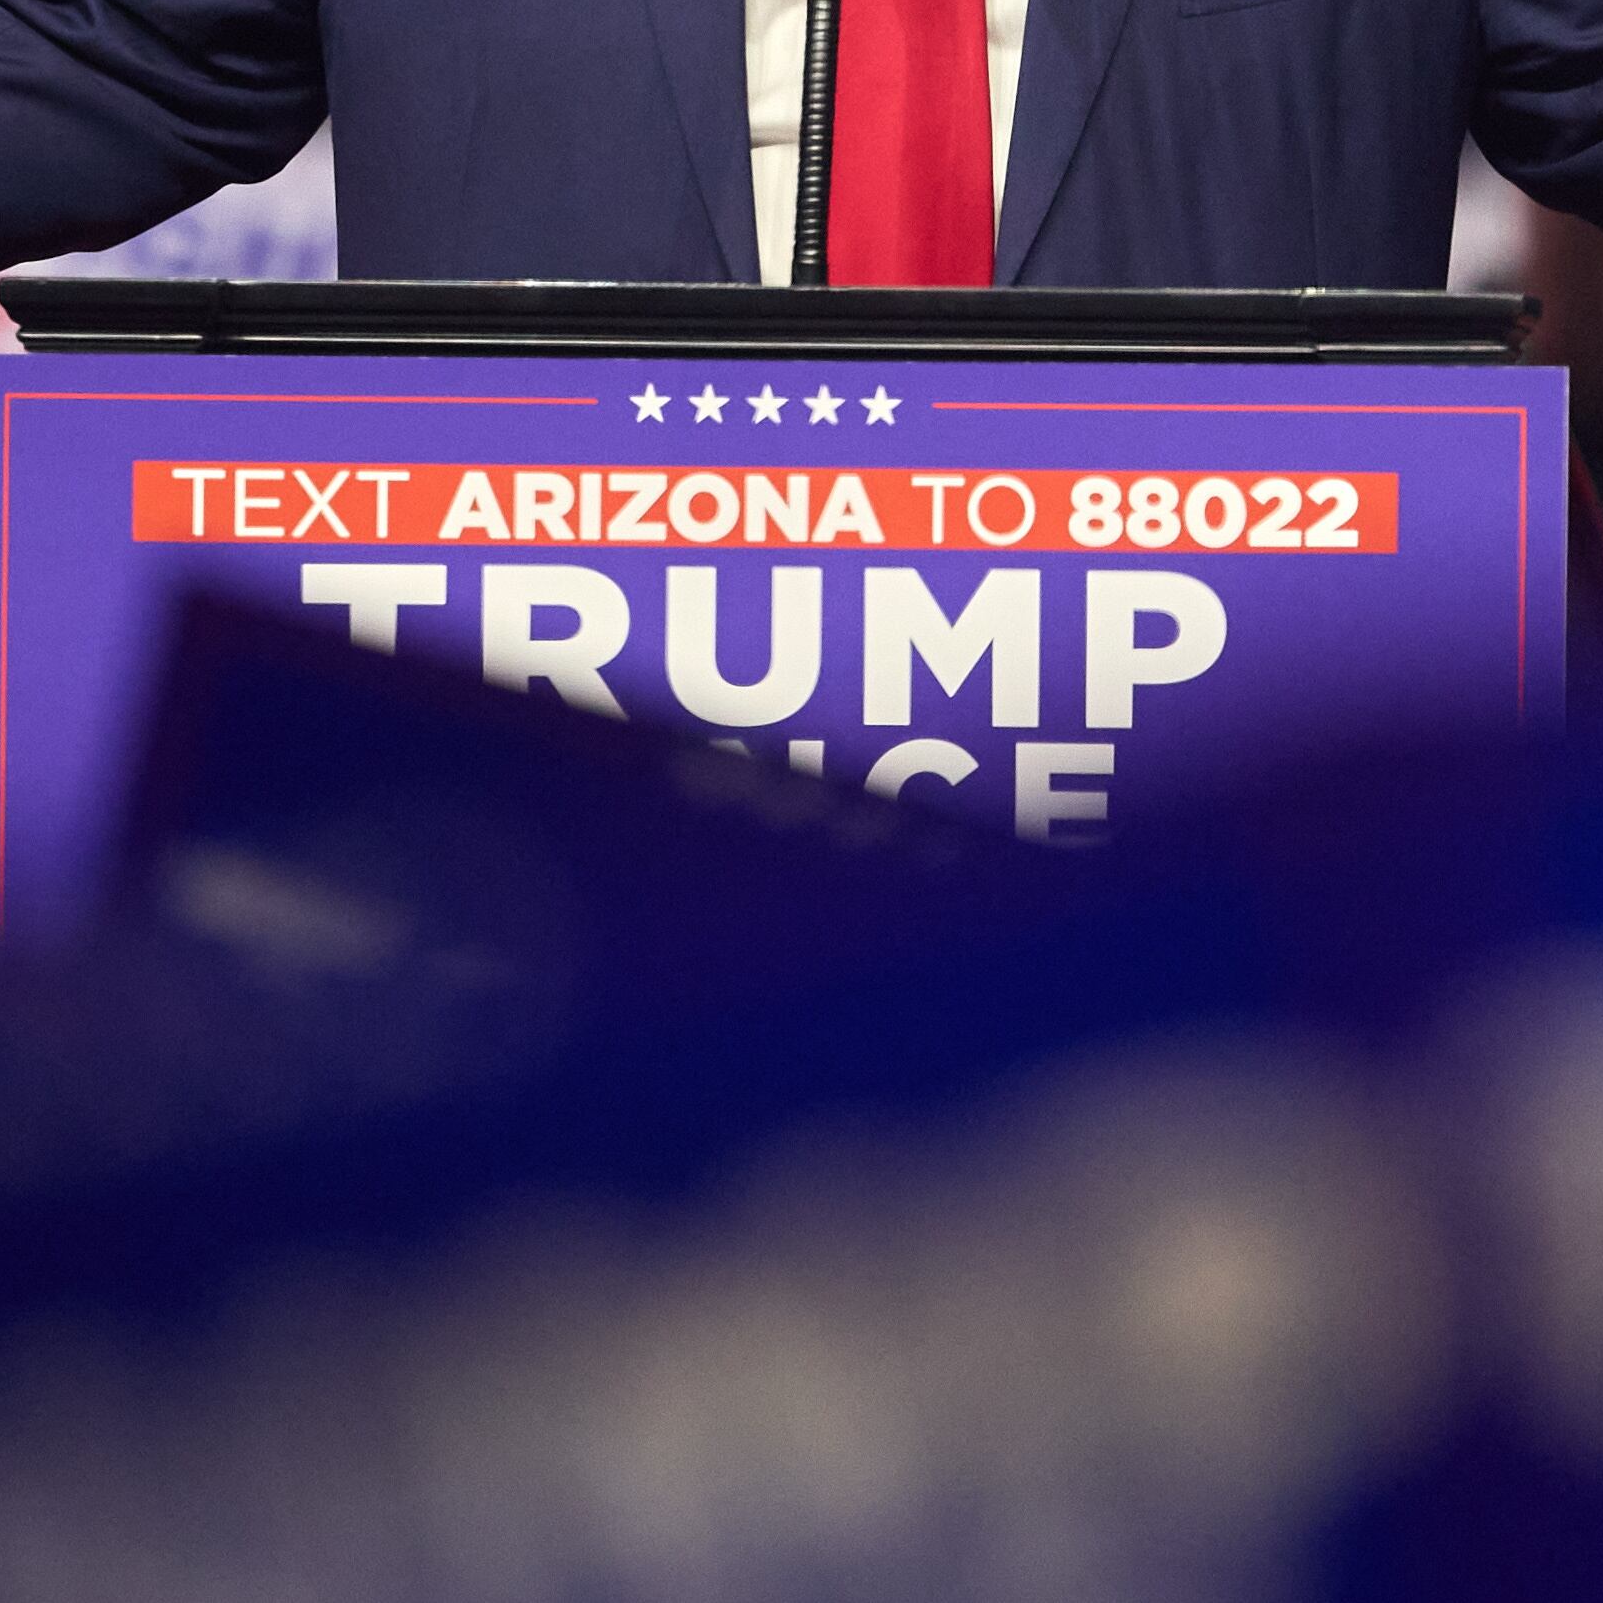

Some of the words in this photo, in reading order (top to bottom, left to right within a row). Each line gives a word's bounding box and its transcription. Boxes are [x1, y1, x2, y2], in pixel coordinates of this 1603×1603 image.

[172, 468, 410, 539] TEXT
[438, 470, 885, 544] ARIZONA
[911, 475, 1036, 546] TO
[1067, 475, 1358, 549] 88022
[301, 562, 1228, 729] TRUMP
